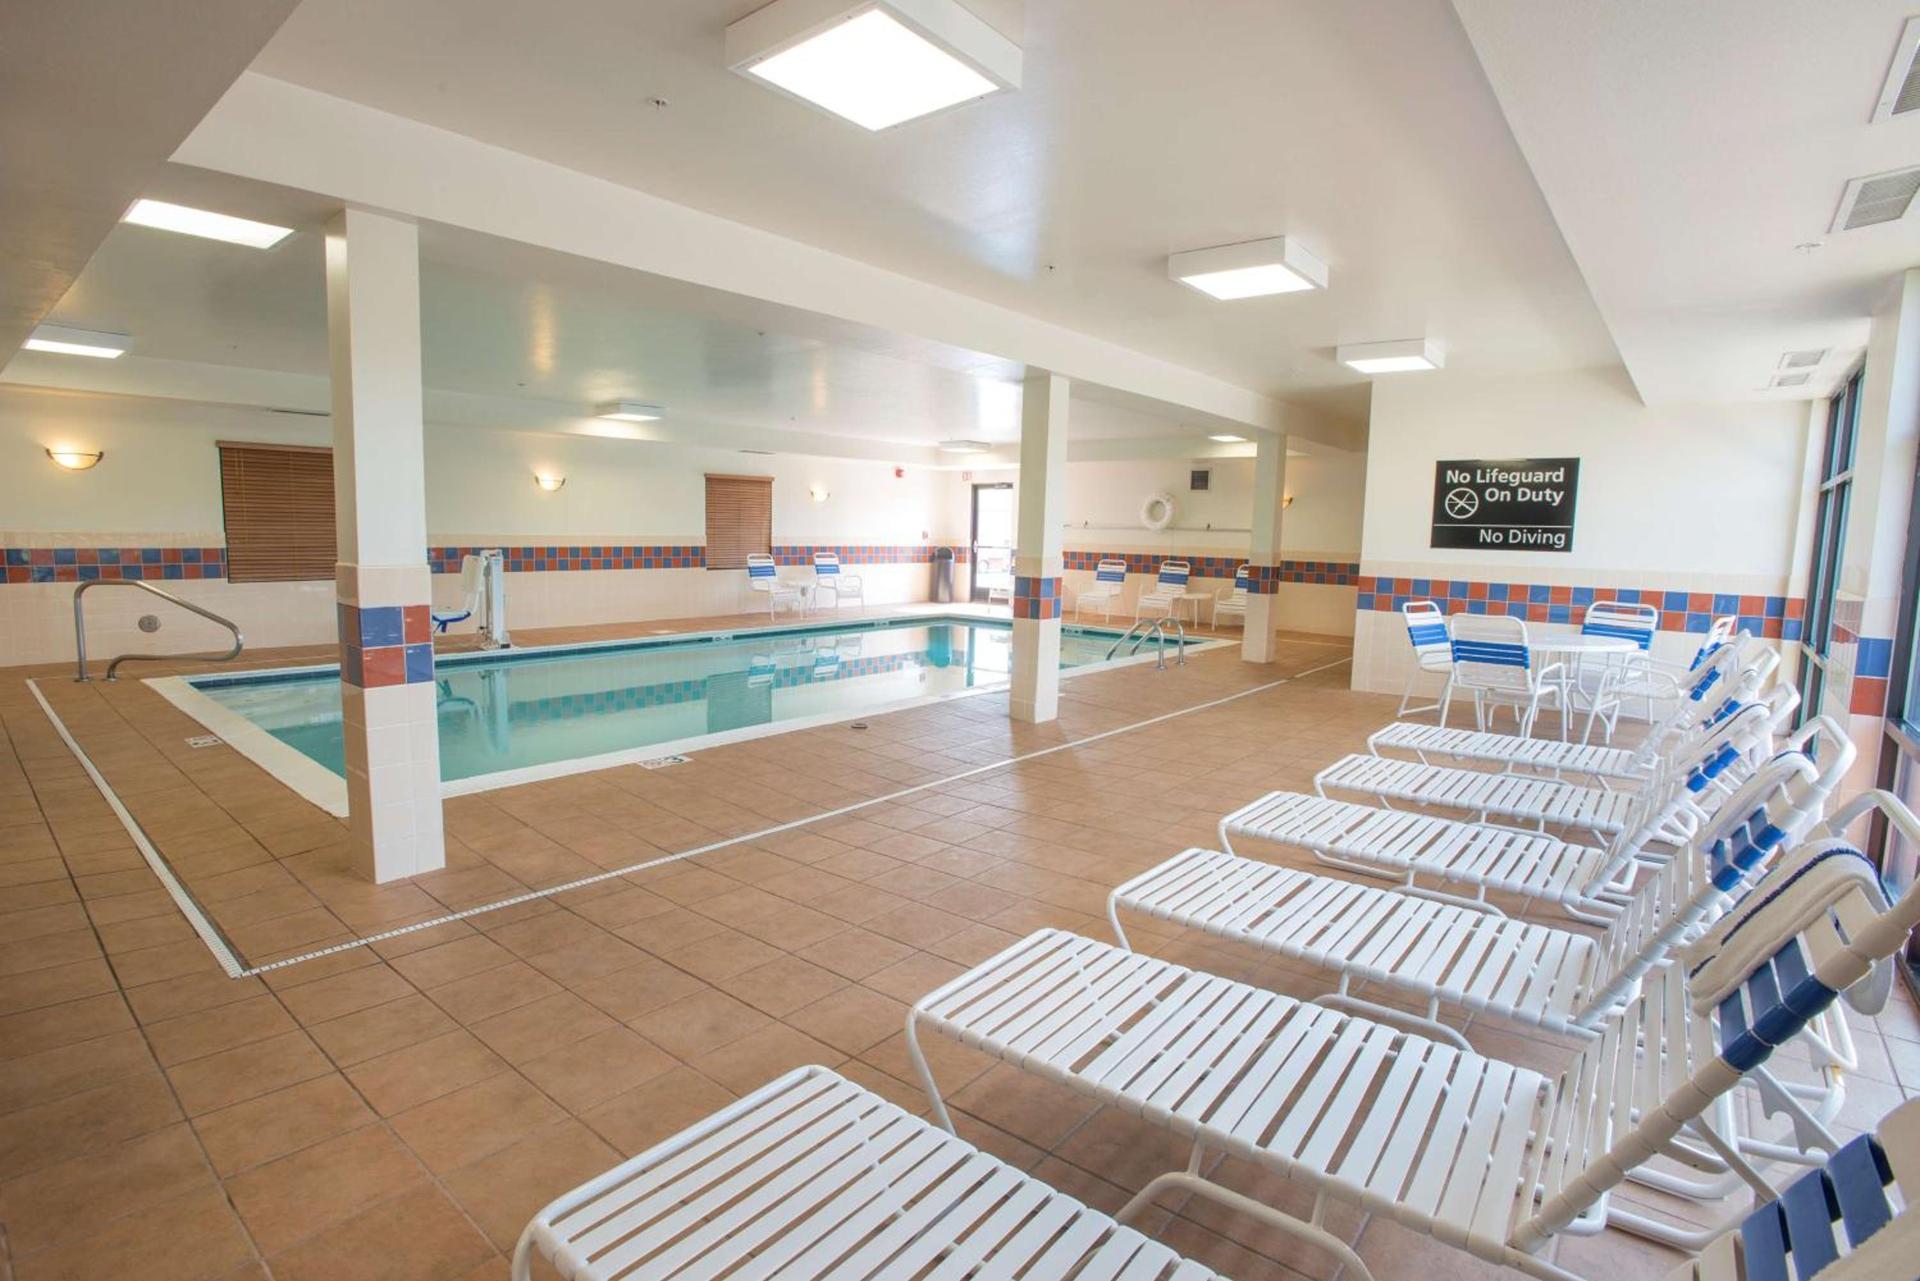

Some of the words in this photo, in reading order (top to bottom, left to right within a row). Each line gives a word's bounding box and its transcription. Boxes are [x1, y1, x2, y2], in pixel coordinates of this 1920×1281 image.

[1446, 470, 1471, 484] No
[1476, 467, 1565, 487] Lifeguard
[1485, 487, 1511, 502] On
[1517, 487, 1564, 506] Duty
[1479, 529, 1503, 543] No
[1508, 529, 1565, 548] Diving
